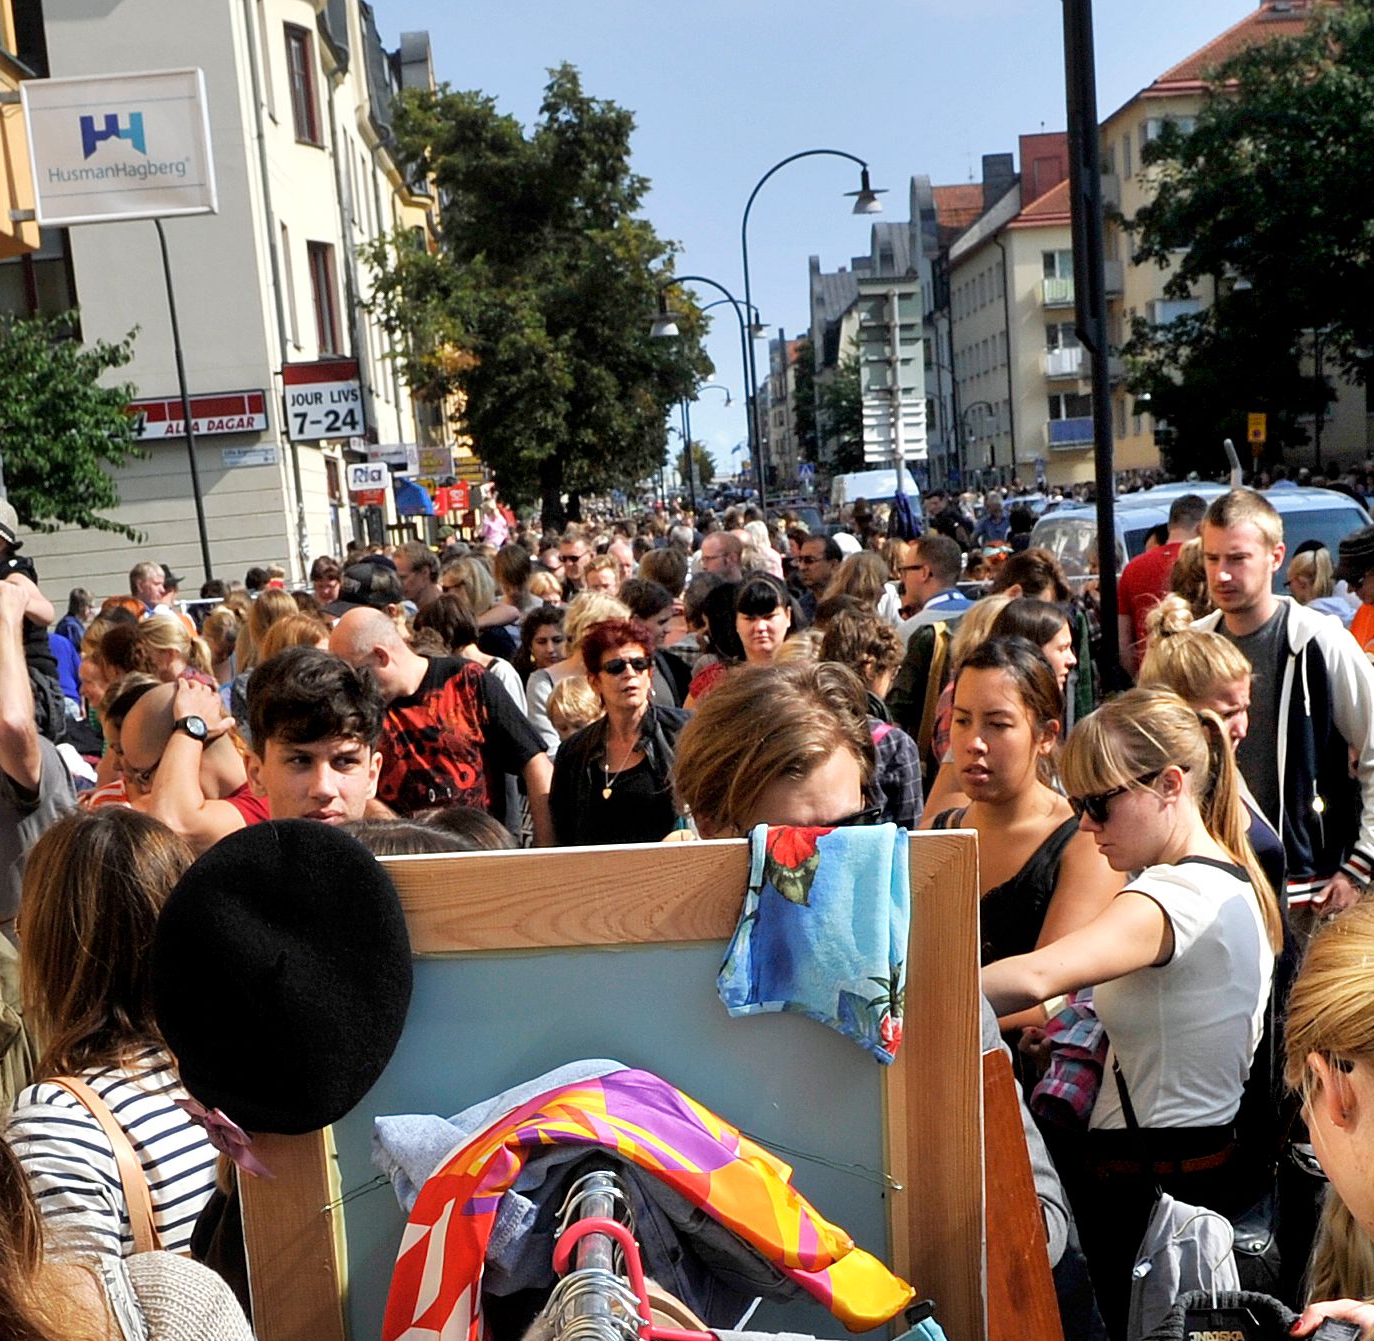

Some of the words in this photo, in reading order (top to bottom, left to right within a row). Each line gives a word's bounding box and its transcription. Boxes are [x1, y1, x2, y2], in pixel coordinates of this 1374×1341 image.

[48, 160, 187, 183] HusmanHagberg
[291, 391, 323, 407] JOUR
[330, 389, 359, 404] LIVS
[206, 416, 255, 432] DAGAR
[293, 408, 359, 435] 7-24
[353, 466, 382, 484] Ria
